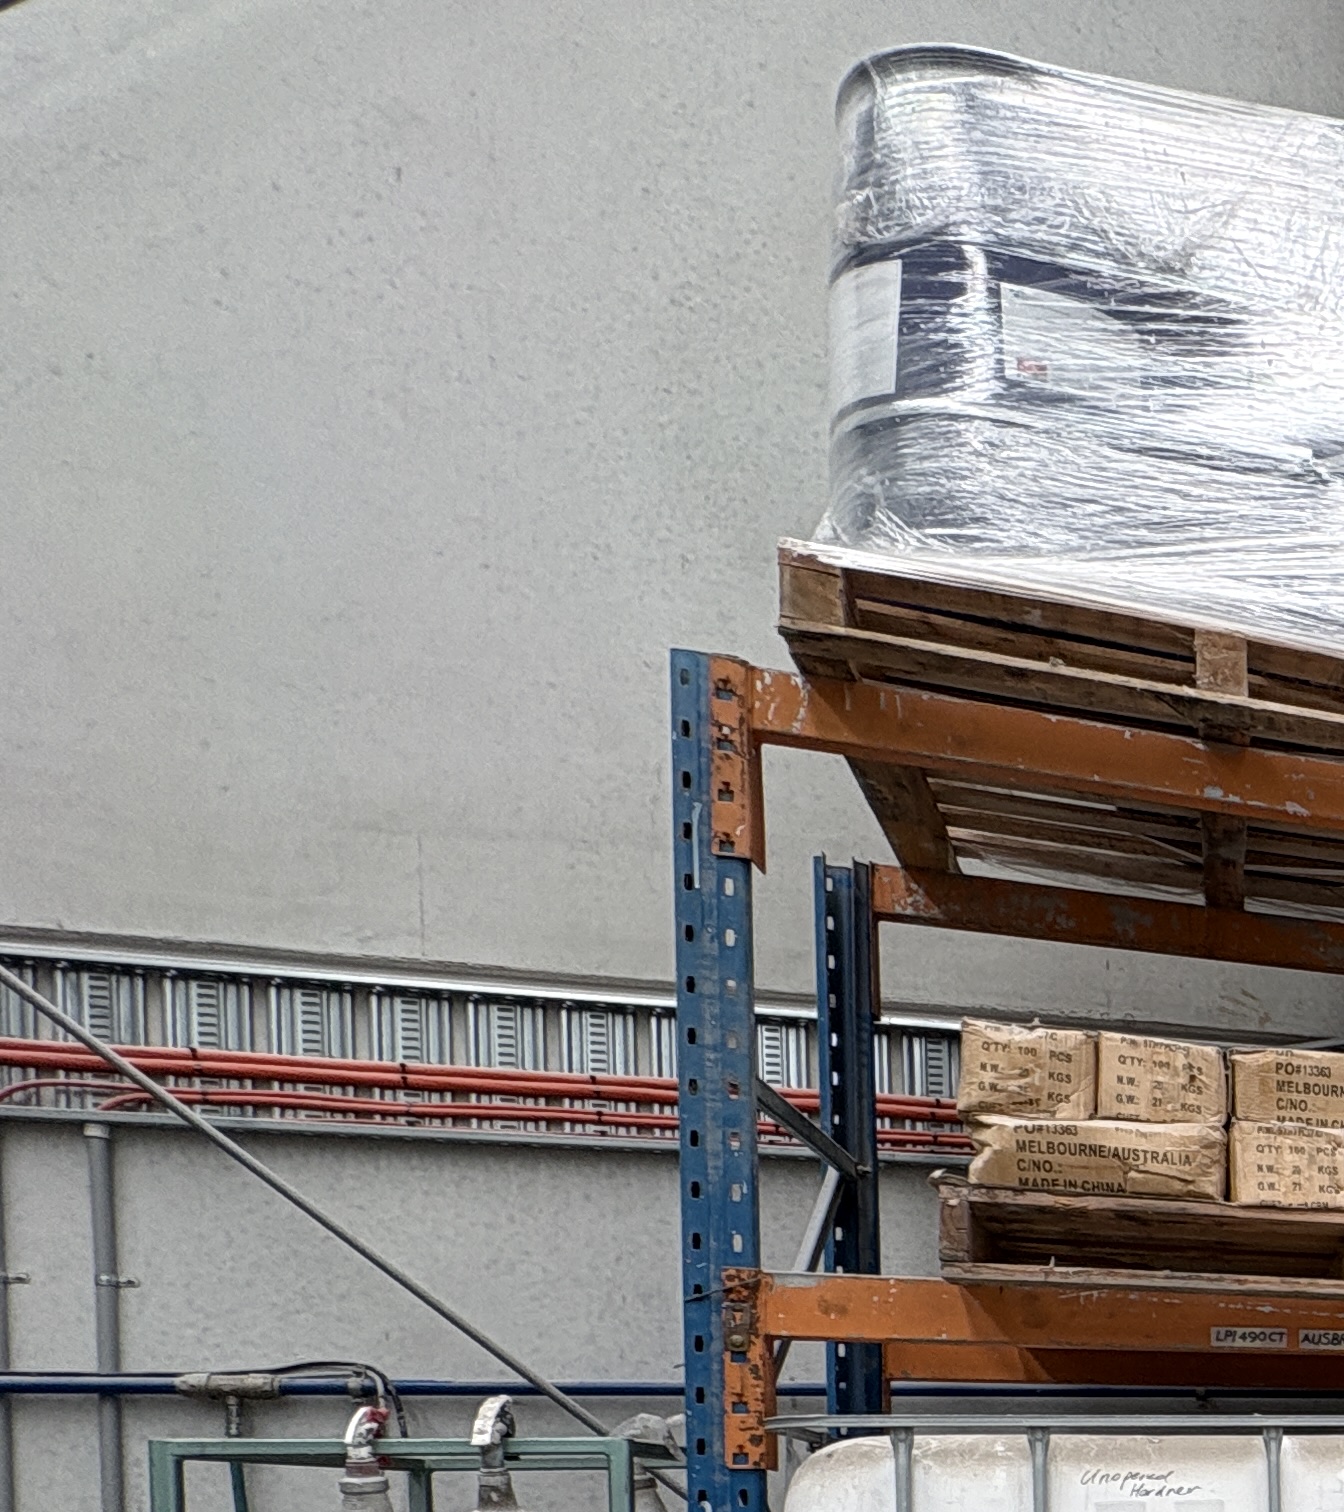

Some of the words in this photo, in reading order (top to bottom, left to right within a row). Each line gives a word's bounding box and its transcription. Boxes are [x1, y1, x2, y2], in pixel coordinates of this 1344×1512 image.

[1049, 1052, 1072, 1064] PCS
[1275, 1062, 1331, 1078] PO#13363
[1048, 1071, 1072, 1084] KGS
[1181, 1083, 1203, 1095] KGS
[1181, 1102, 1202, 1114] KGS
[1015, 1139, 1192, 1167] MELBOURNE/AUSTRALIA
[1318, 1166, 1339, 1176] KGS
